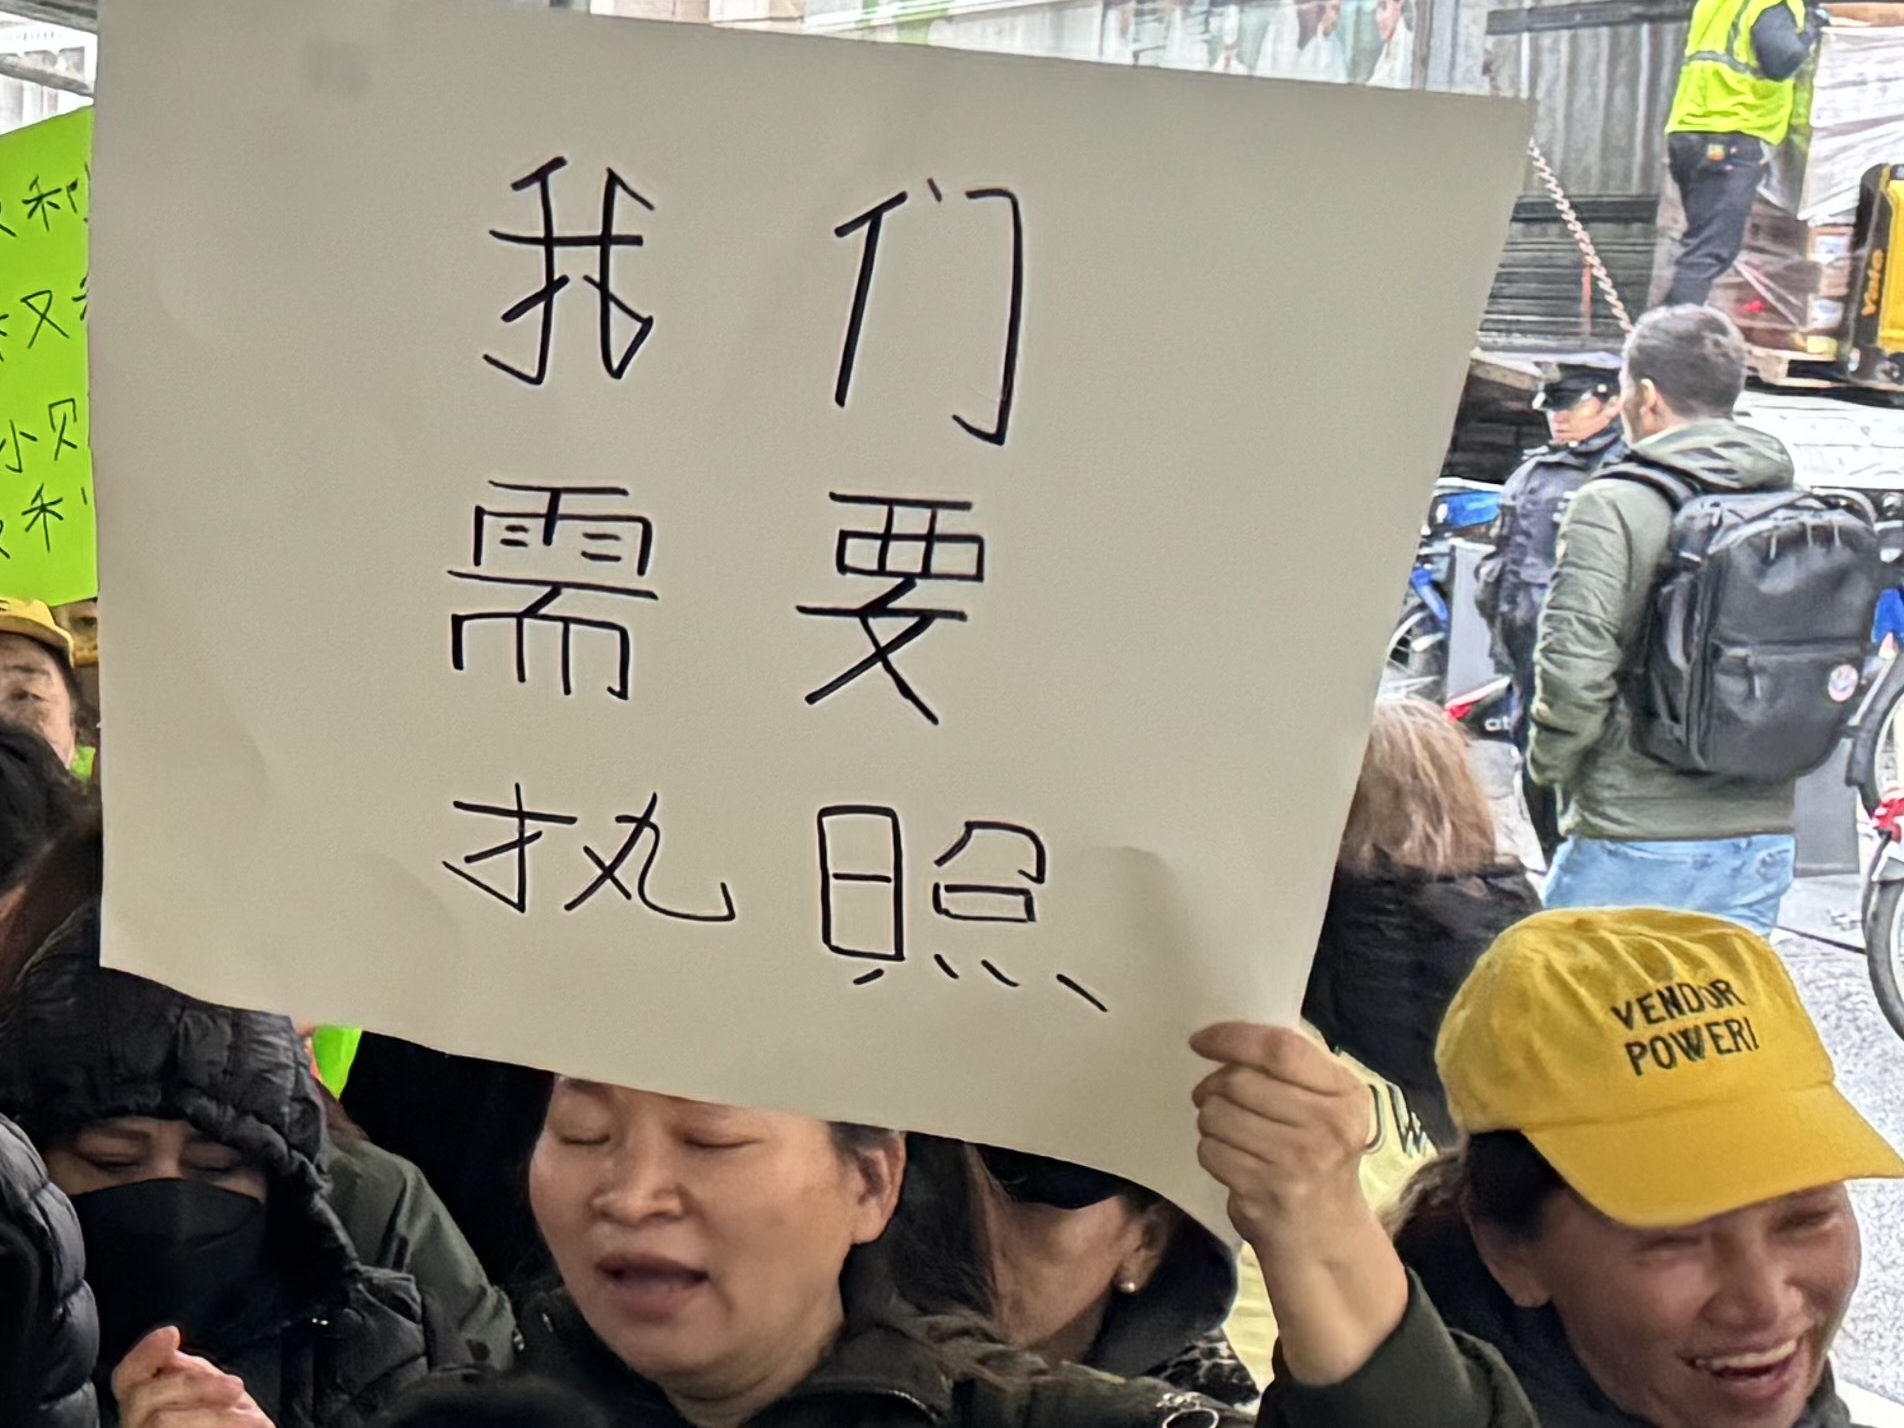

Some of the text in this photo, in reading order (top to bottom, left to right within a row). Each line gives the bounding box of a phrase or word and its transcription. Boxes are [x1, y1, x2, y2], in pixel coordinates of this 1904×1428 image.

[446, 478, 986, 724] 需要
[441, 780, 1108, 1013] 执照
[1610, 976, 1747, 1032] VENDOR
